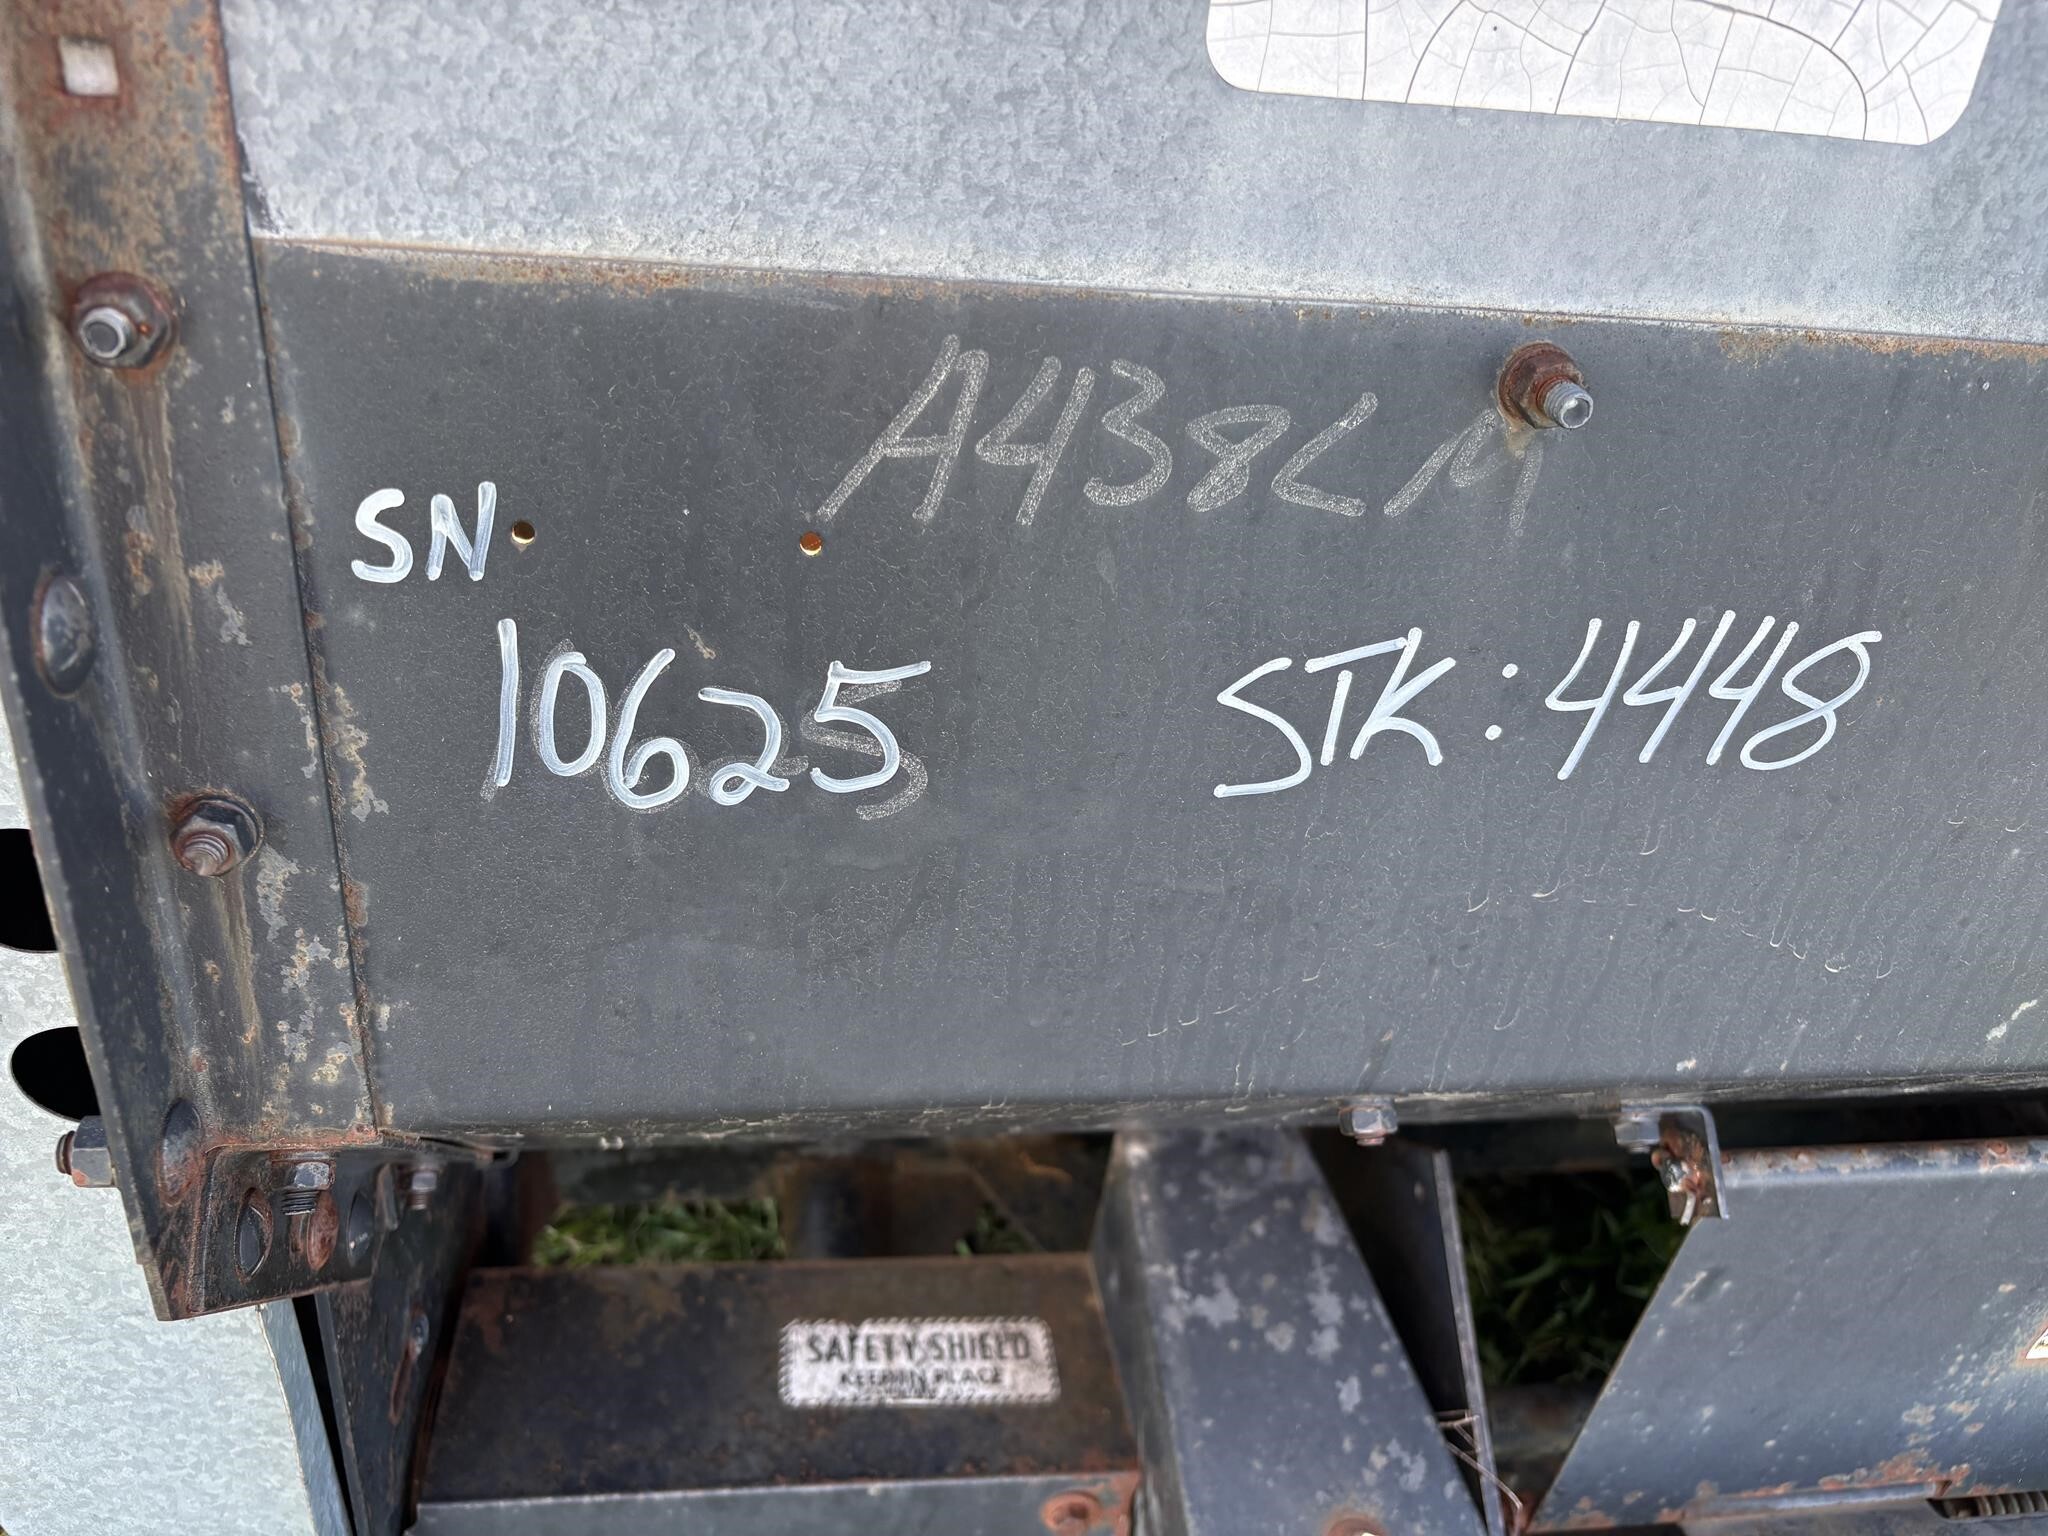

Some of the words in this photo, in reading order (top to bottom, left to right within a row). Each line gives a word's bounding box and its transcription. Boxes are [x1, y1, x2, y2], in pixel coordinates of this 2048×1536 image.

[351, 481, 496, 584] SN
[497, 618, 932, 812] 10625
[1544, 609, 1882, 782] 4448
[808, 1331, 917, 1363] SAFETY
[931, 1332, 1033, 1361] SHIELD
